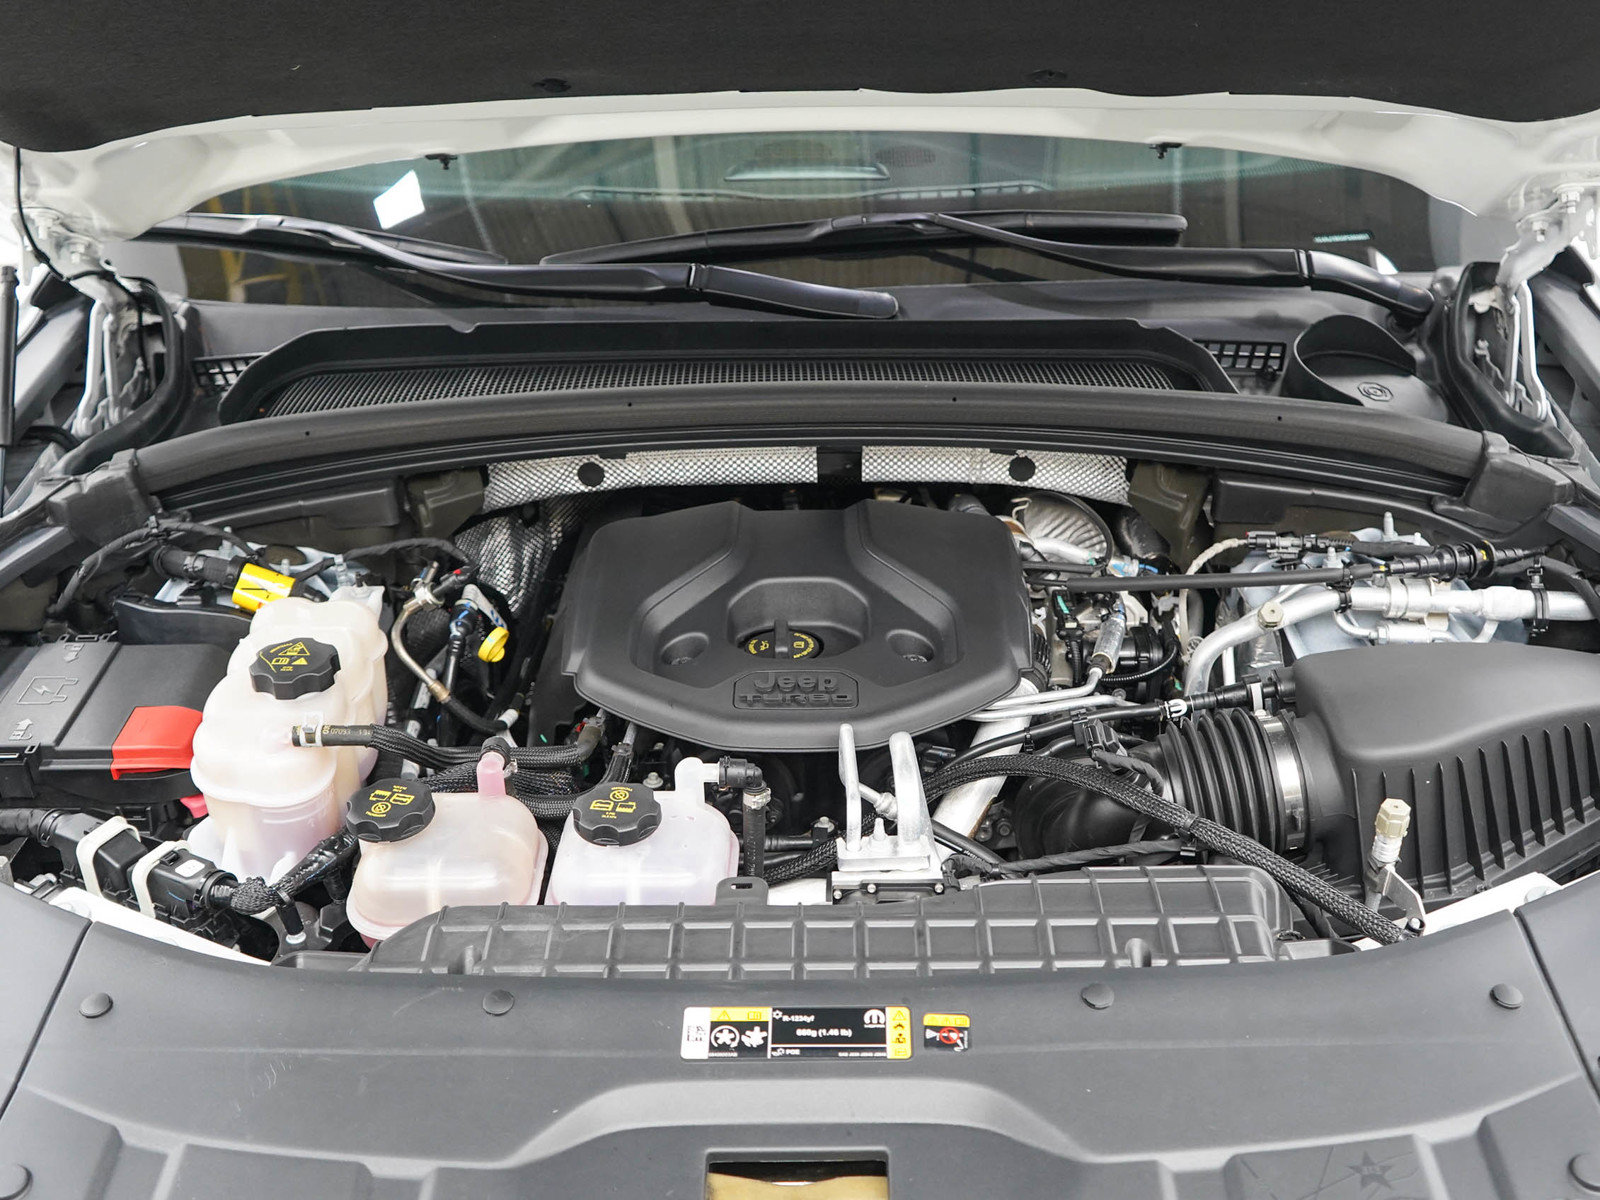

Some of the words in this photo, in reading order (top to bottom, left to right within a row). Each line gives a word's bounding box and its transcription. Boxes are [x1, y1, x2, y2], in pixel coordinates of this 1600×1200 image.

[754, 672, 838, 693] Jeep
[739, 694, 853, 707] TURBO
[840, 1028, 853, 1038] lb)
